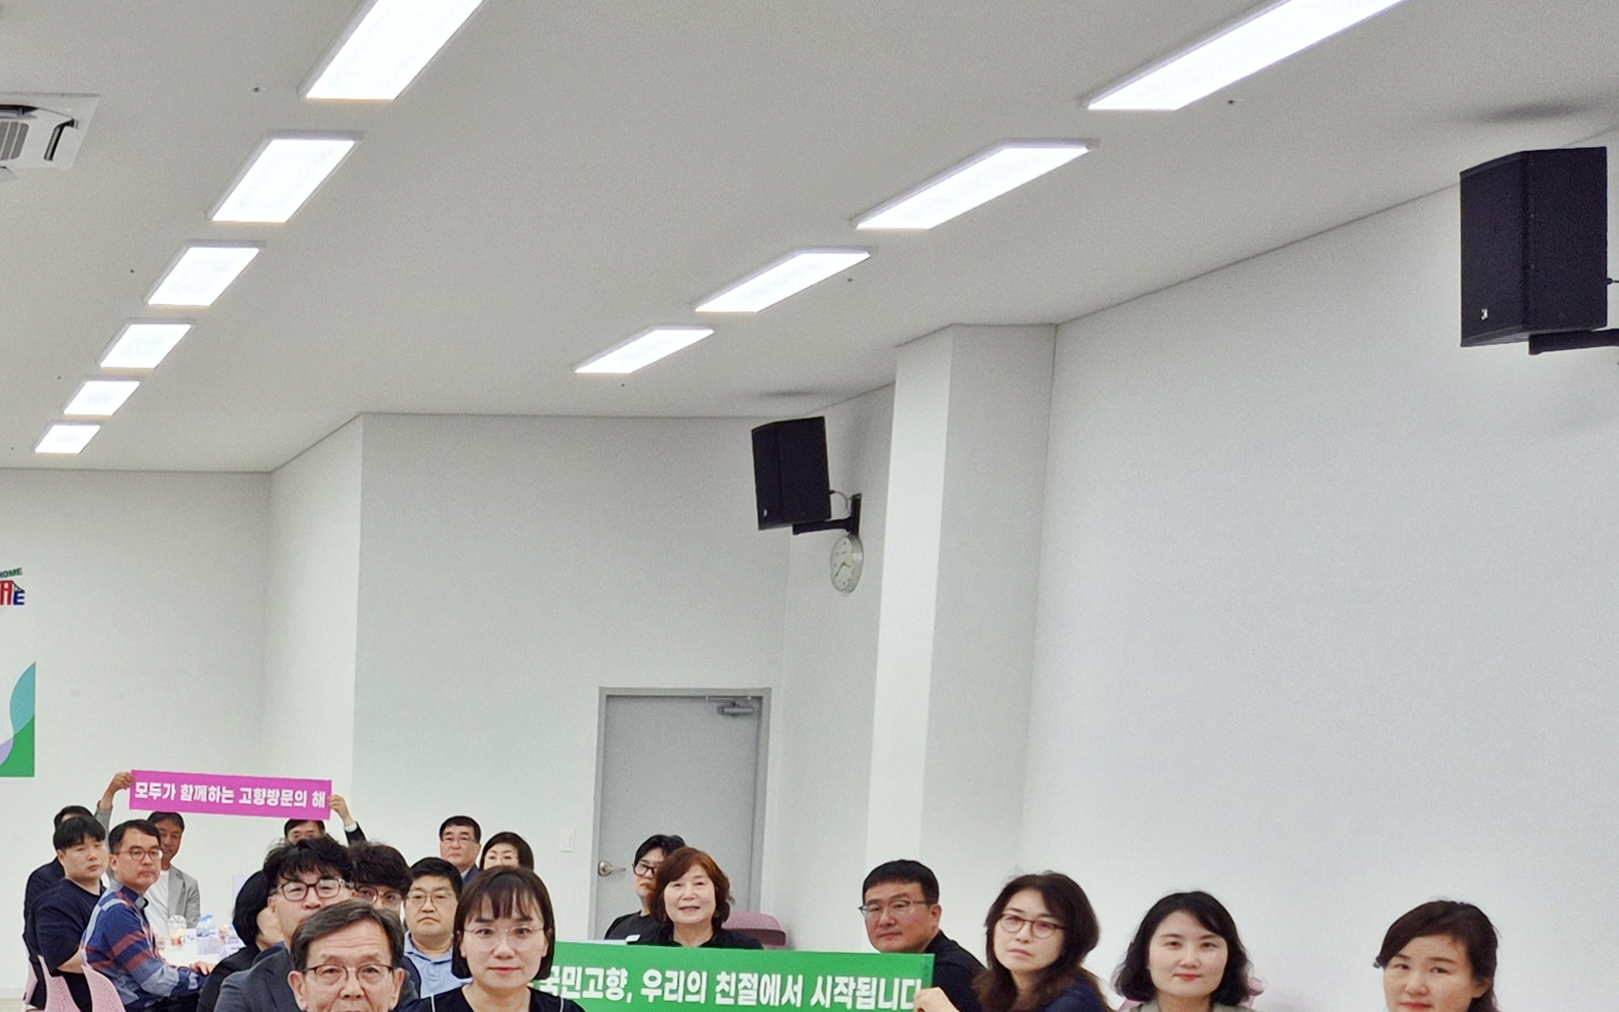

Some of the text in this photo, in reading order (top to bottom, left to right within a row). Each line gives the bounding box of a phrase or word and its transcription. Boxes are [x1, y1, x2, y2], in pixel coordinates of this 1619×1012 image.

[134, 781, 327, 809] 모두가 함께하는 고향방문의 해
[538, 964, 923, 1012] 국민고향, 우리의 친절에서 시작됩니다
